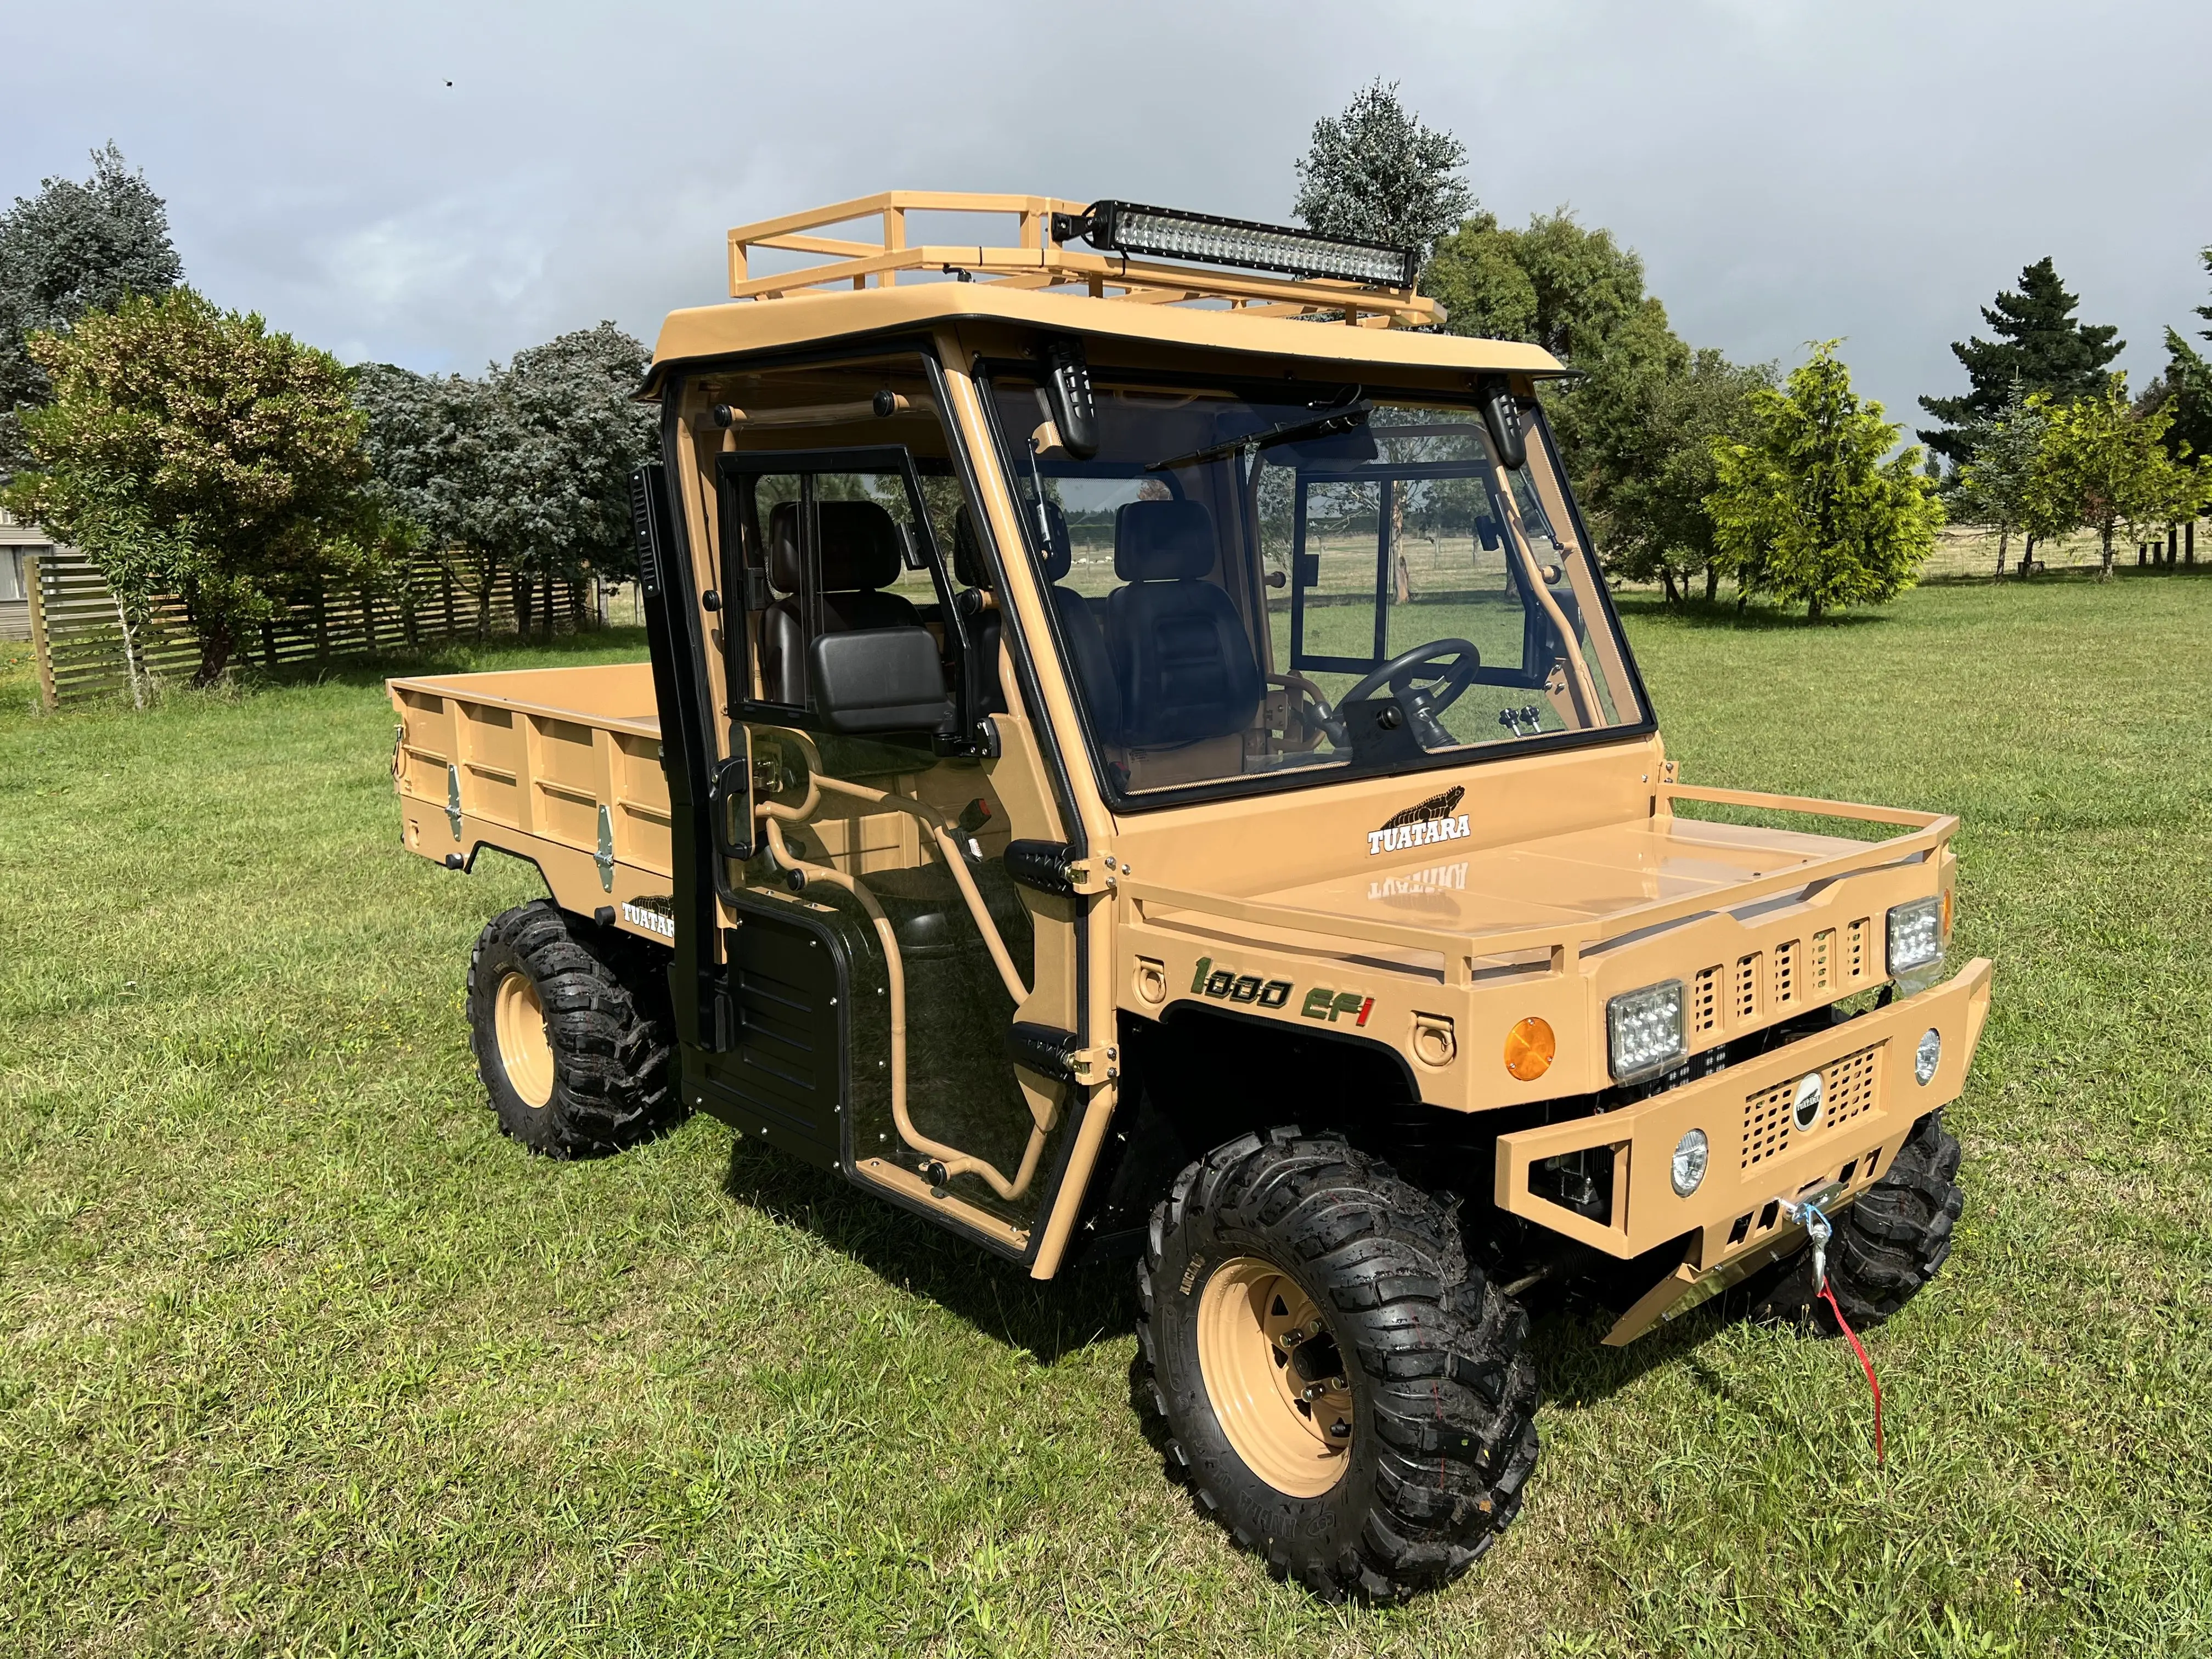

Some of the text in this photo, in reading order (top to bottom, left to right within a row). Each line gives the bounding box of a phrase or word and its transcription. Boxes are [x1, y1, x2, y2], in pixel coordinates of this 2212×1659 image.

[1367, 814, 1470, 855] TUATARA
[622, 901, 674, 938] TUATAR
[1190, 956, 1295, 1009] 1000
[1797, 1096, 1820, 1111] TUATARA
